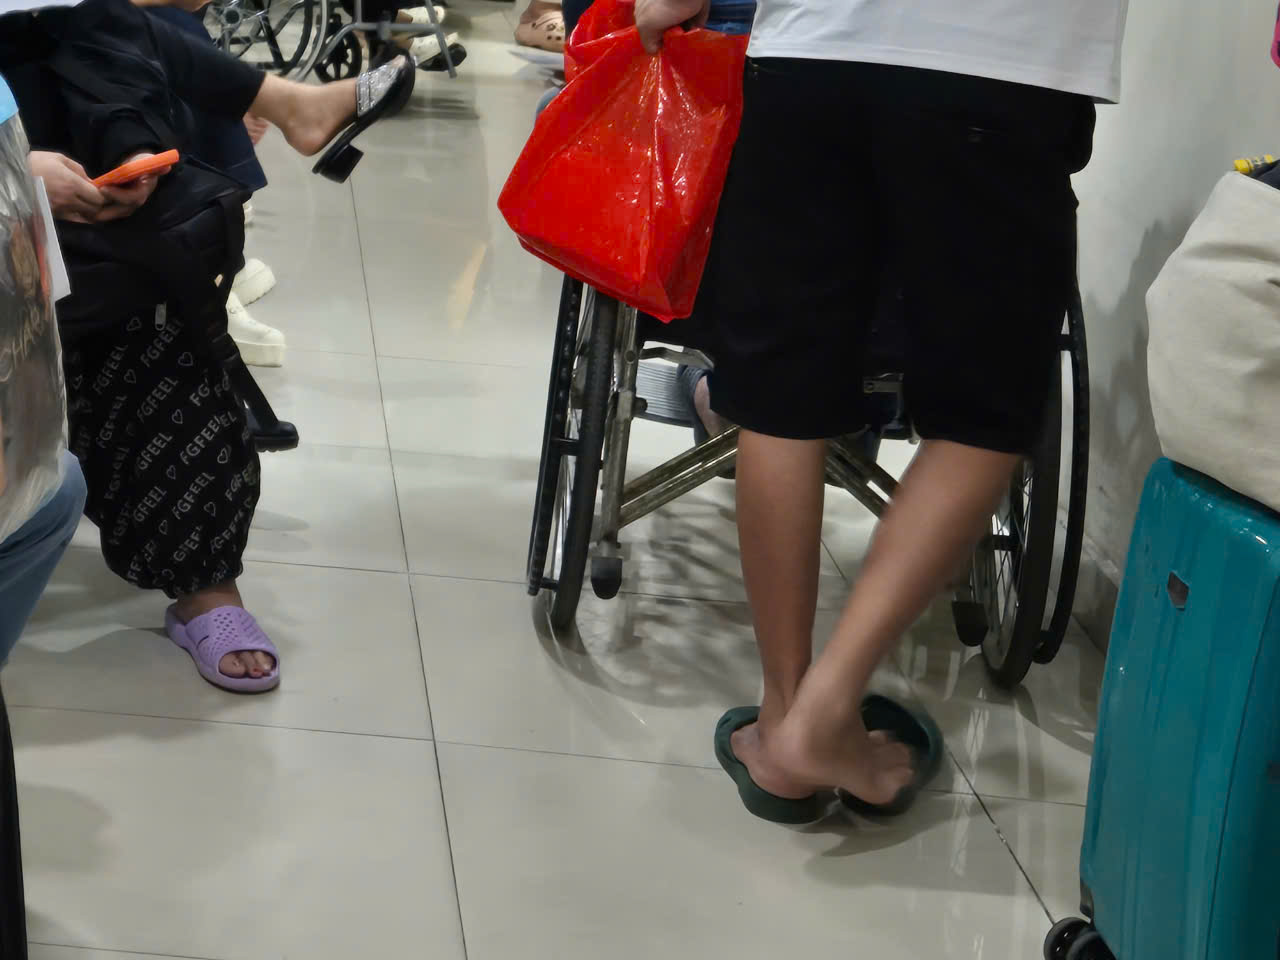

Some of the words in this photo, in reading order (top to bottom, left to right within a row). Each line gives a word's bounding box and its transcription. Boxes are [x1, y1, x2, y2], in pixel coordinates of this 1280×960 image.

[136, 376, 179, 423] FGFEEL
[136, 432, 174, 471] GFEEL
[131, 485, 168, 524] GFEEL
[171, 472, 216, 520] FGFEEL
